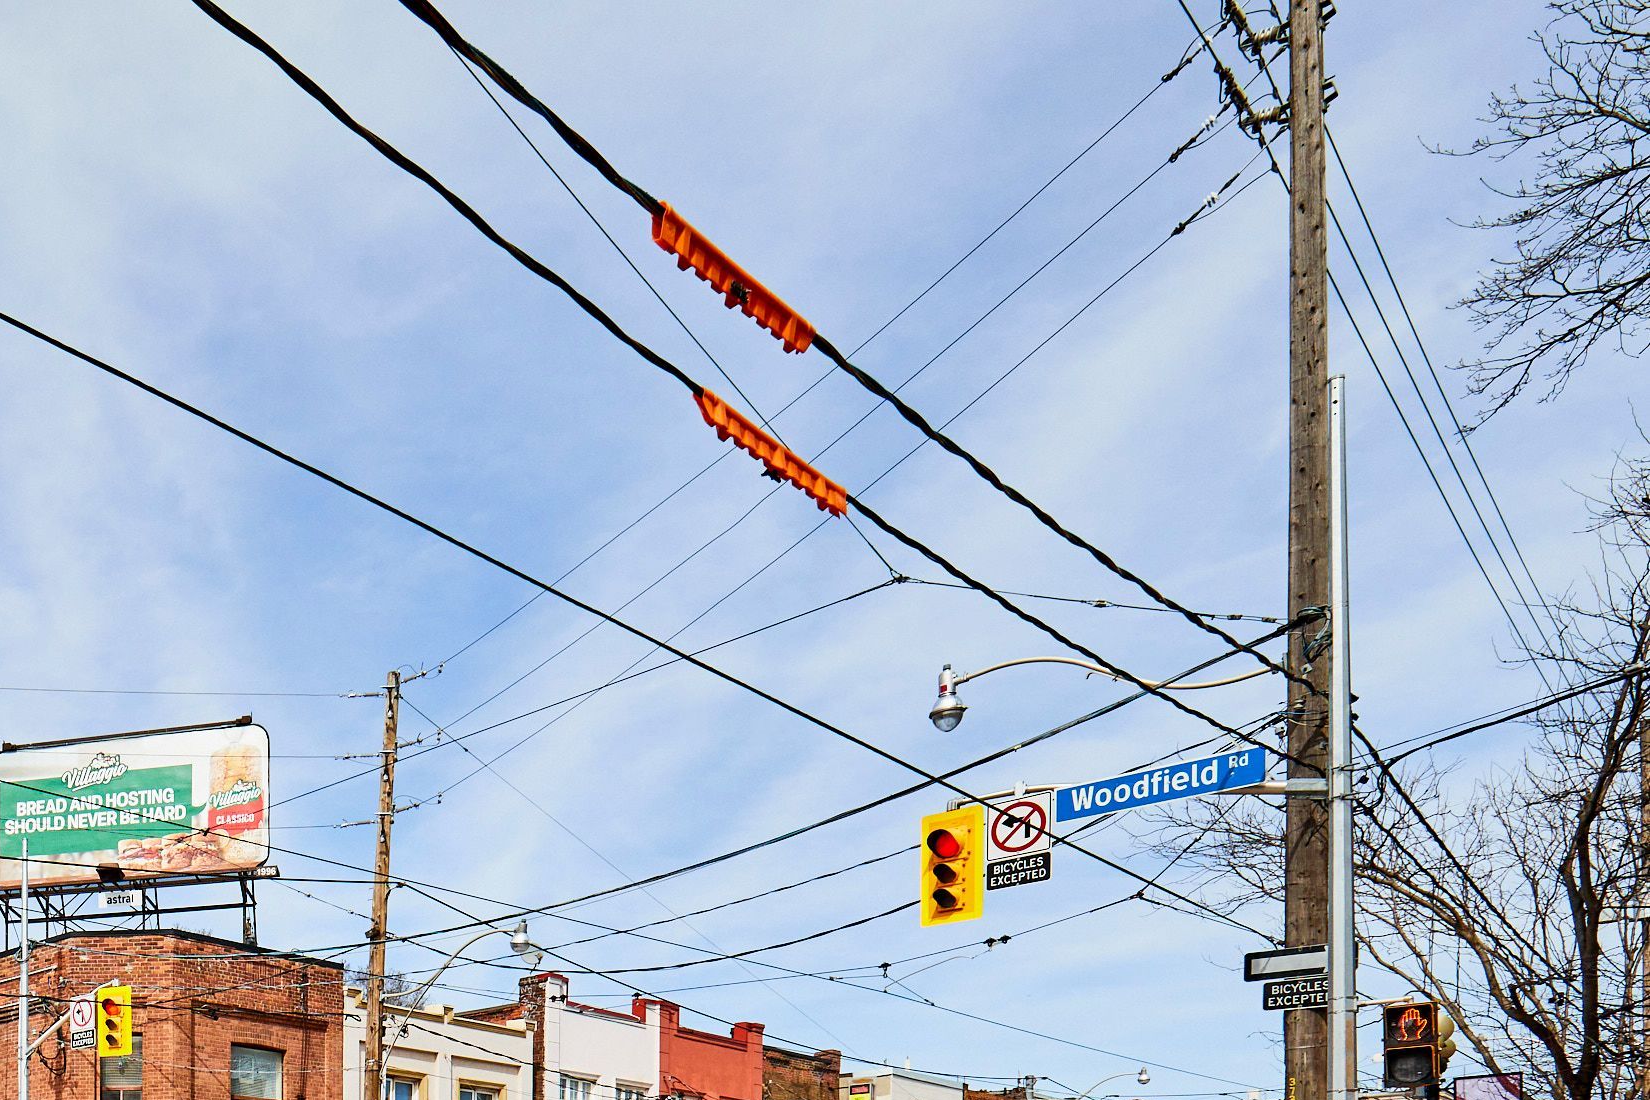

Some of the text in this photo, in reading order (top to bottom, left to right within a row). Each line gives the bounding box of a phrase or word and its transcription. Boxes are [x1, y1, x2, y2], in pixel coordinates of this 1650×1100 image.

[62, 762, 128, 791] Villaggio
[1071, 753, 1249, 812] Woodfield Rd
[16, 788, 175, 817] BREAD AND HOSTING
[209, 785, 263, 810] Villaggio
[4, 805, 187, 836] SHOULD NEVER BE HARD
[216, 812, 255, 826] CLASSICO
[256, 867, 277, 877] 1996
[993, 857, 1044, 875] BICYCLES
[990, 868, 1047, 887] EXCEPTED
[106, 893, 134, 906] astral
[1271, 980, 1328, 995] BICYCLES
[1267, 992, 1328, 1007] EXCEPTE
[72, 1038, 94, 1047] EXCEPTED
[73, 1031, 93, 1039] BICYCLES
